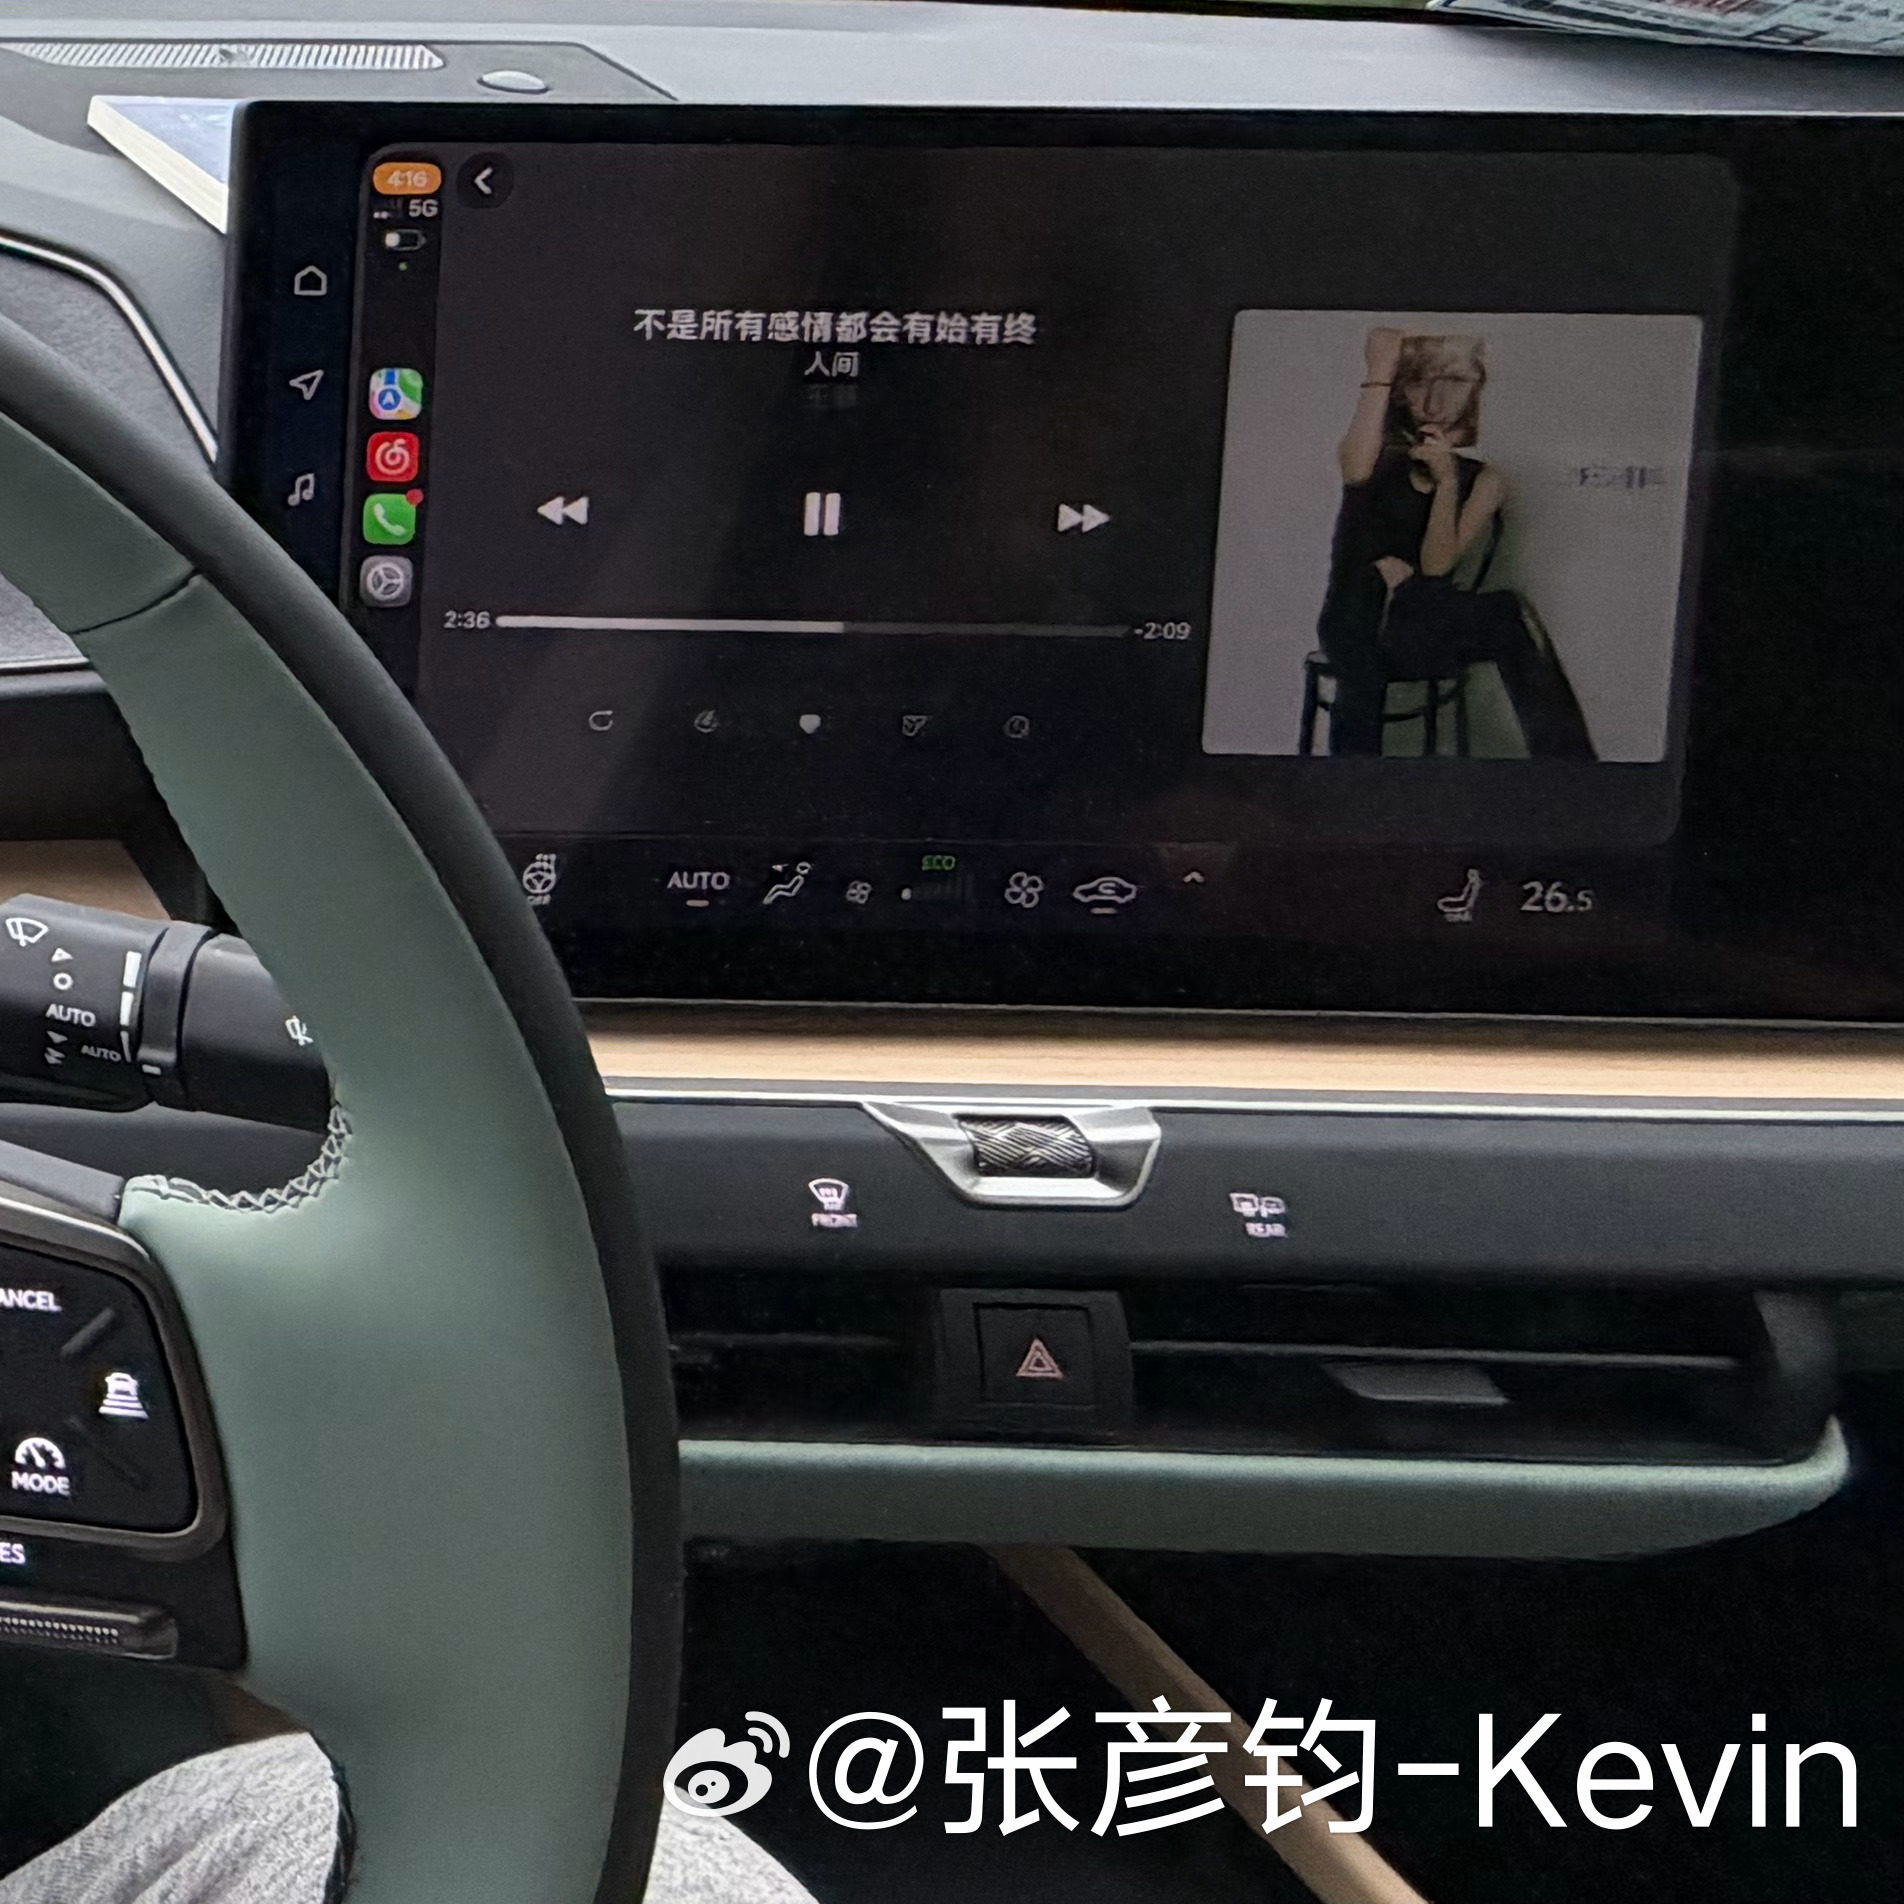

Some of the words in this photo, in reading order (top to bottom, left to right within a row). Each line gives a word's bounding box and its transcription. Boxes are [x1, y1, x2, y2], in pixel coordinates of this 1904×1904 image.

[409, 199, 438, 217] 5G
[633, 308, 1037, 345] 不是所有感情都会有始有终
[803, 351, 860, 377] 人间
[444, 610, 490, 629] 2:36
[667, 871, 730, 890] AUTO
[1520, 881, 1593, 912] 26.5
[45, 1003, 96, 1027] AUTO
[80, 1044, 121, 1062] AUTO
[11, 1471, 71, 1496] MODE
